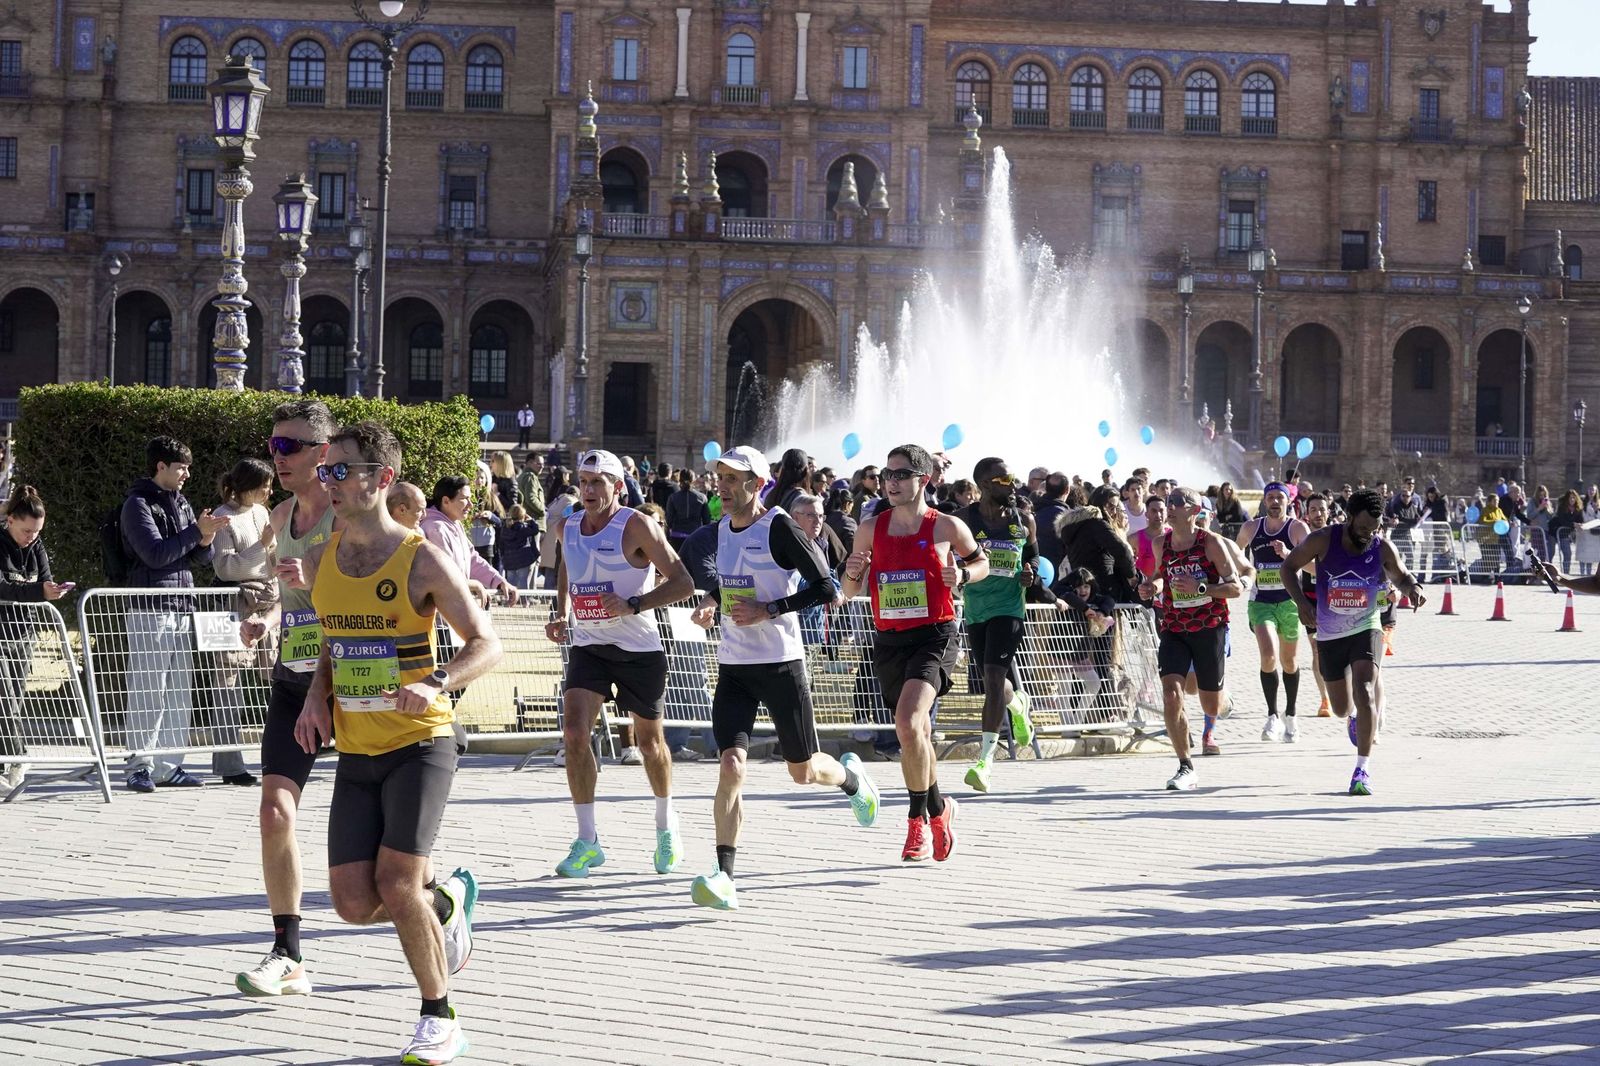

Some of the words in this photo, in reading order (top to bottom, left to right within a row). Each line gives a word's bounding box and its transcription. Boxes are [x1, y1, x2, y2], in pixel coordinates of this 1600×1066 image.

[1167, 562, 1202, 576] KENYA
[891, 572, 919, 581] ZURICH
[724, 578, 748, 586] ZURICH
[580, 584, 607, 593] ZURICH
[893, 587, 908, 595] 1537
[583, 599, 598, 607] 1289
[884, 595, 919, 608] ÁLVARO
[1330, 598, 1365, 607] ANTHONY
[297, 612, 320, 623] ZURIC
[576, 608, 608, 618] GRACIE
[207, 616, 232, 634] AMS
[326, 614, 385, 630] STRAGGLERS
[386, 618, 398, 629] RC
[301, 631, 318, 642] 2050
[348, 645, 387, 656] ZURICH
[351, 667, 371, 677] 1727
[333, 684, 360, 696] UNCLE
